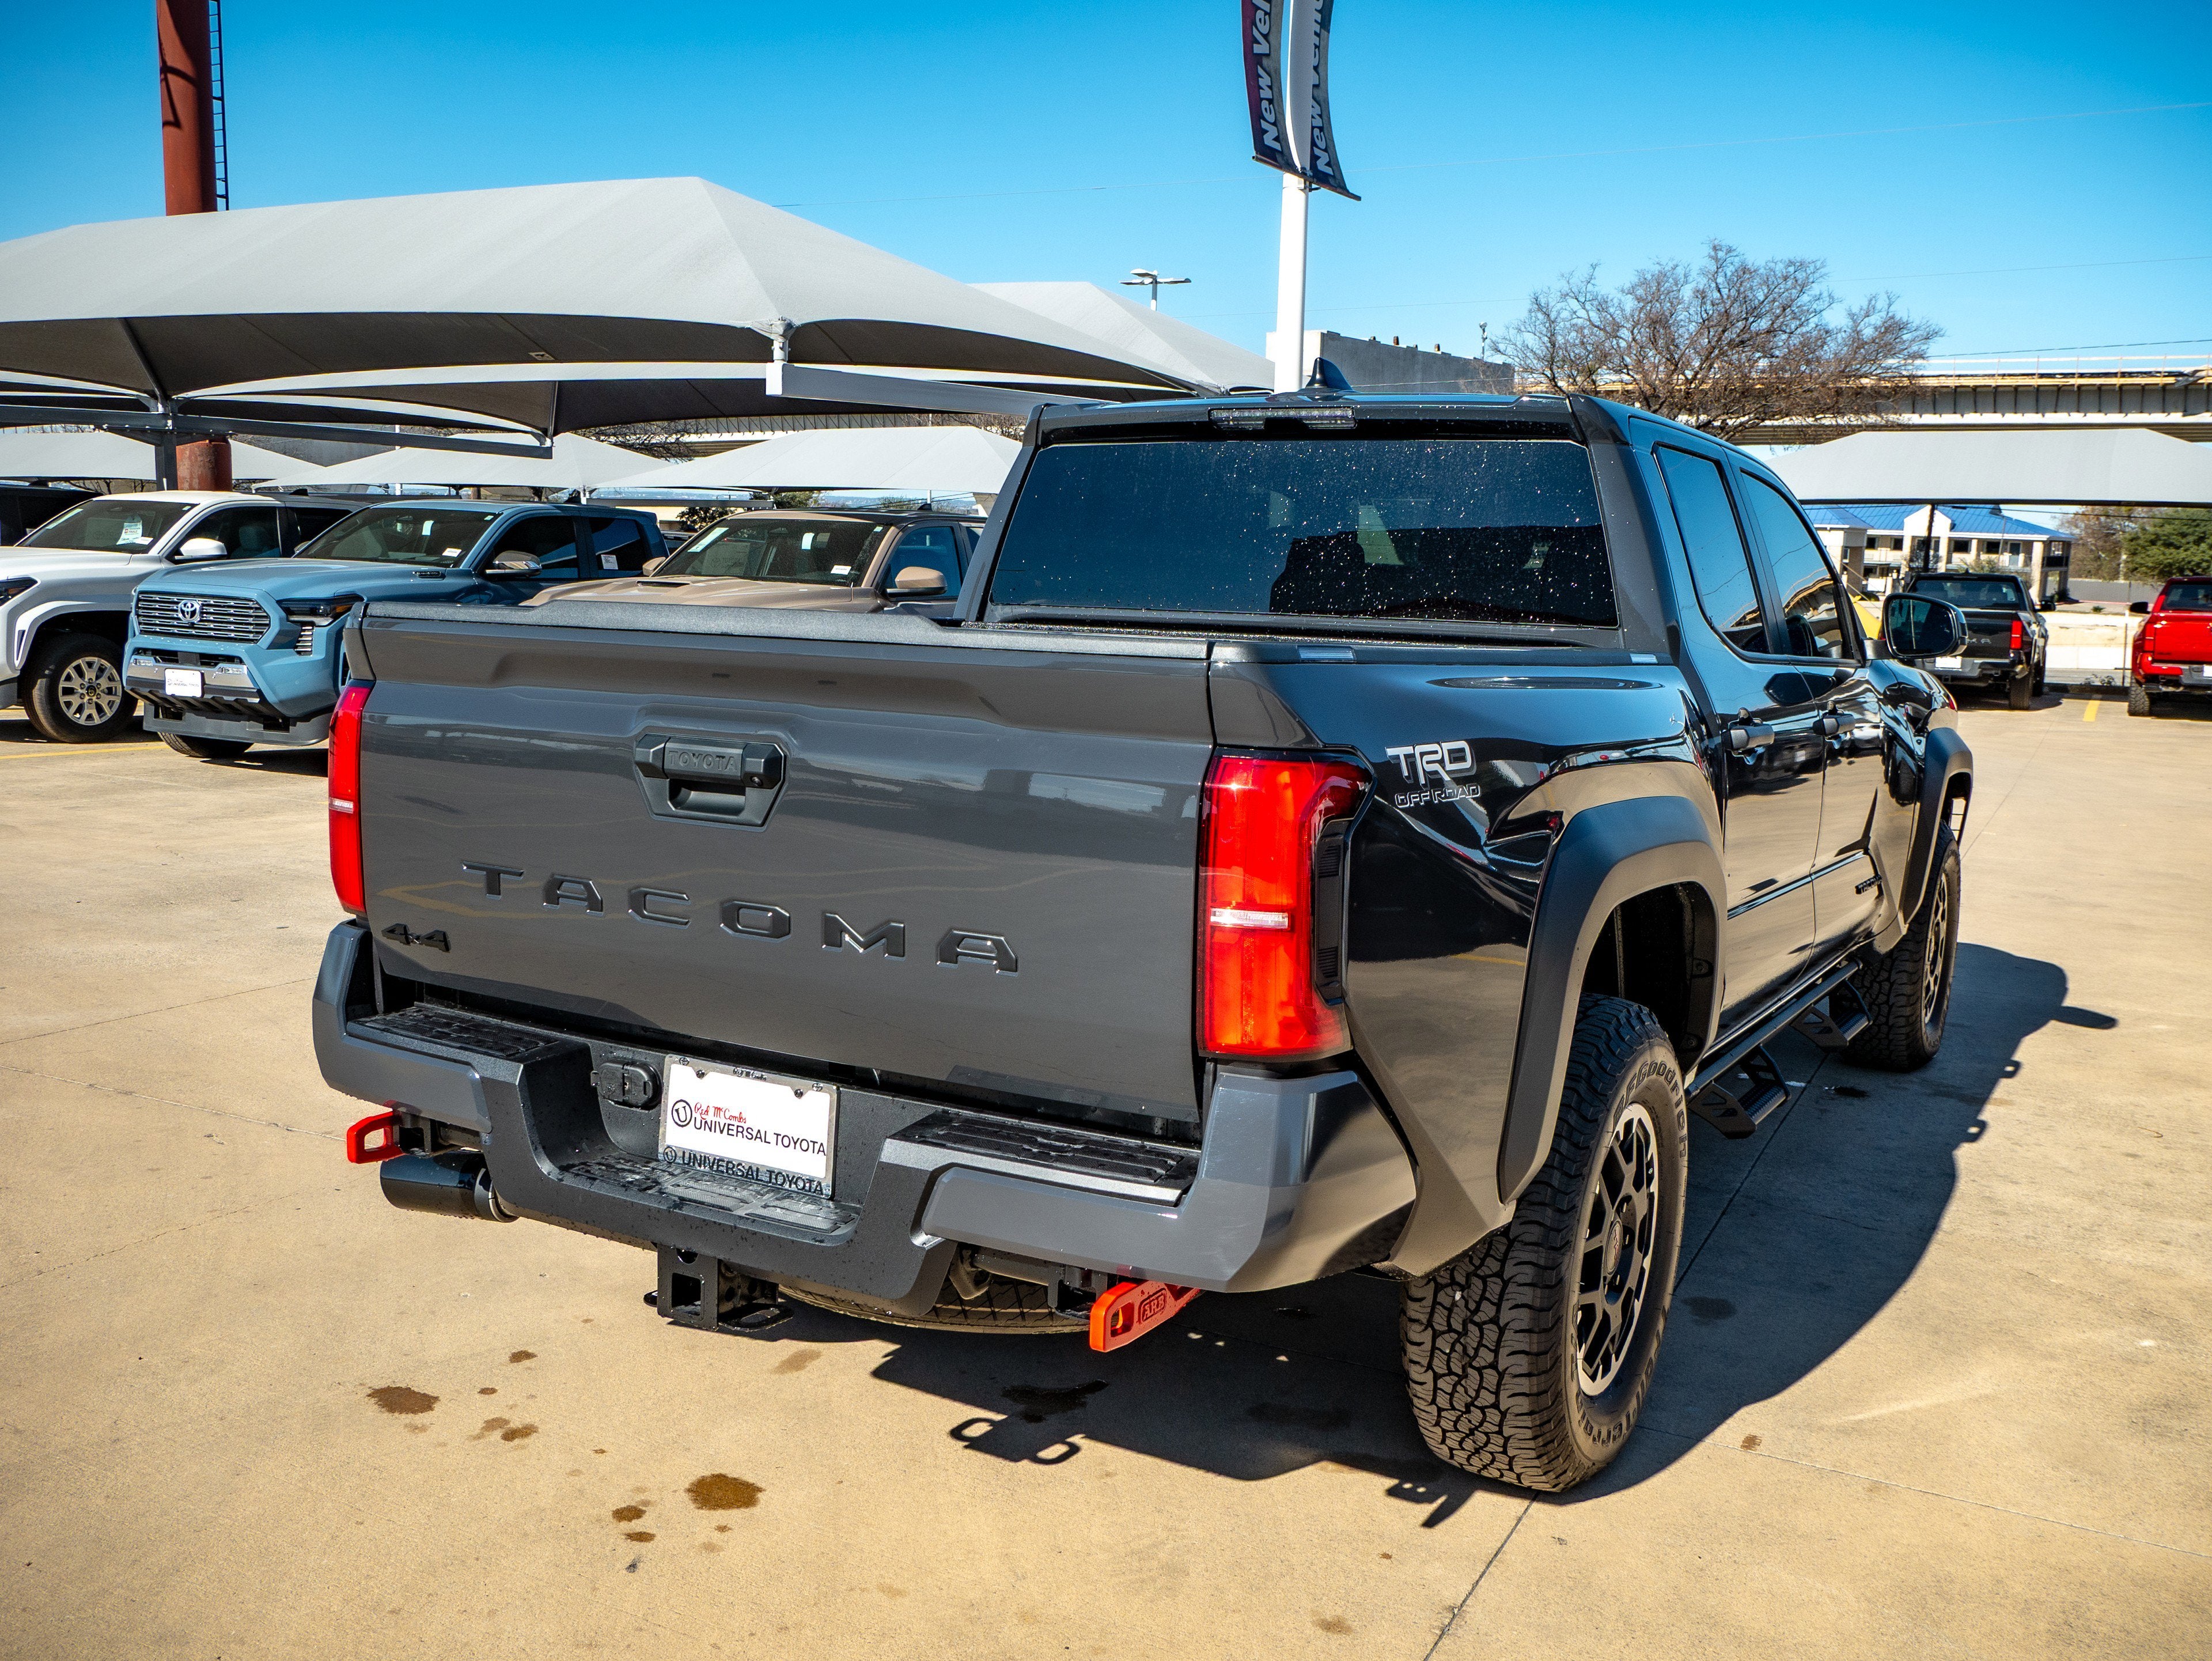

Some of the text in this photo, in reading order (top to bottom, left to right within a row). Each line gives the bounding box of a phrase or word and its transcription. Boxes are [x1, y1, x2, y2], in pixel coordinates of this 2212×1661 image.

[1257, 65, 1282, 152] New
[1311, 98, 1335, 176] New
[668, 751, 738, 773] TOYOTA
[1385, 740, 1472, 785] TRD
[462, 860, 1018, 977] TACOMA
[694, 1102, 710, 1120] Red
[694, 1117, 826, 1156] UNIVERSAL TOYOTA
[682, 1150, 765, 1182] UNIVERSAL
[766, 1168, 824, 1196] TOYOTA
